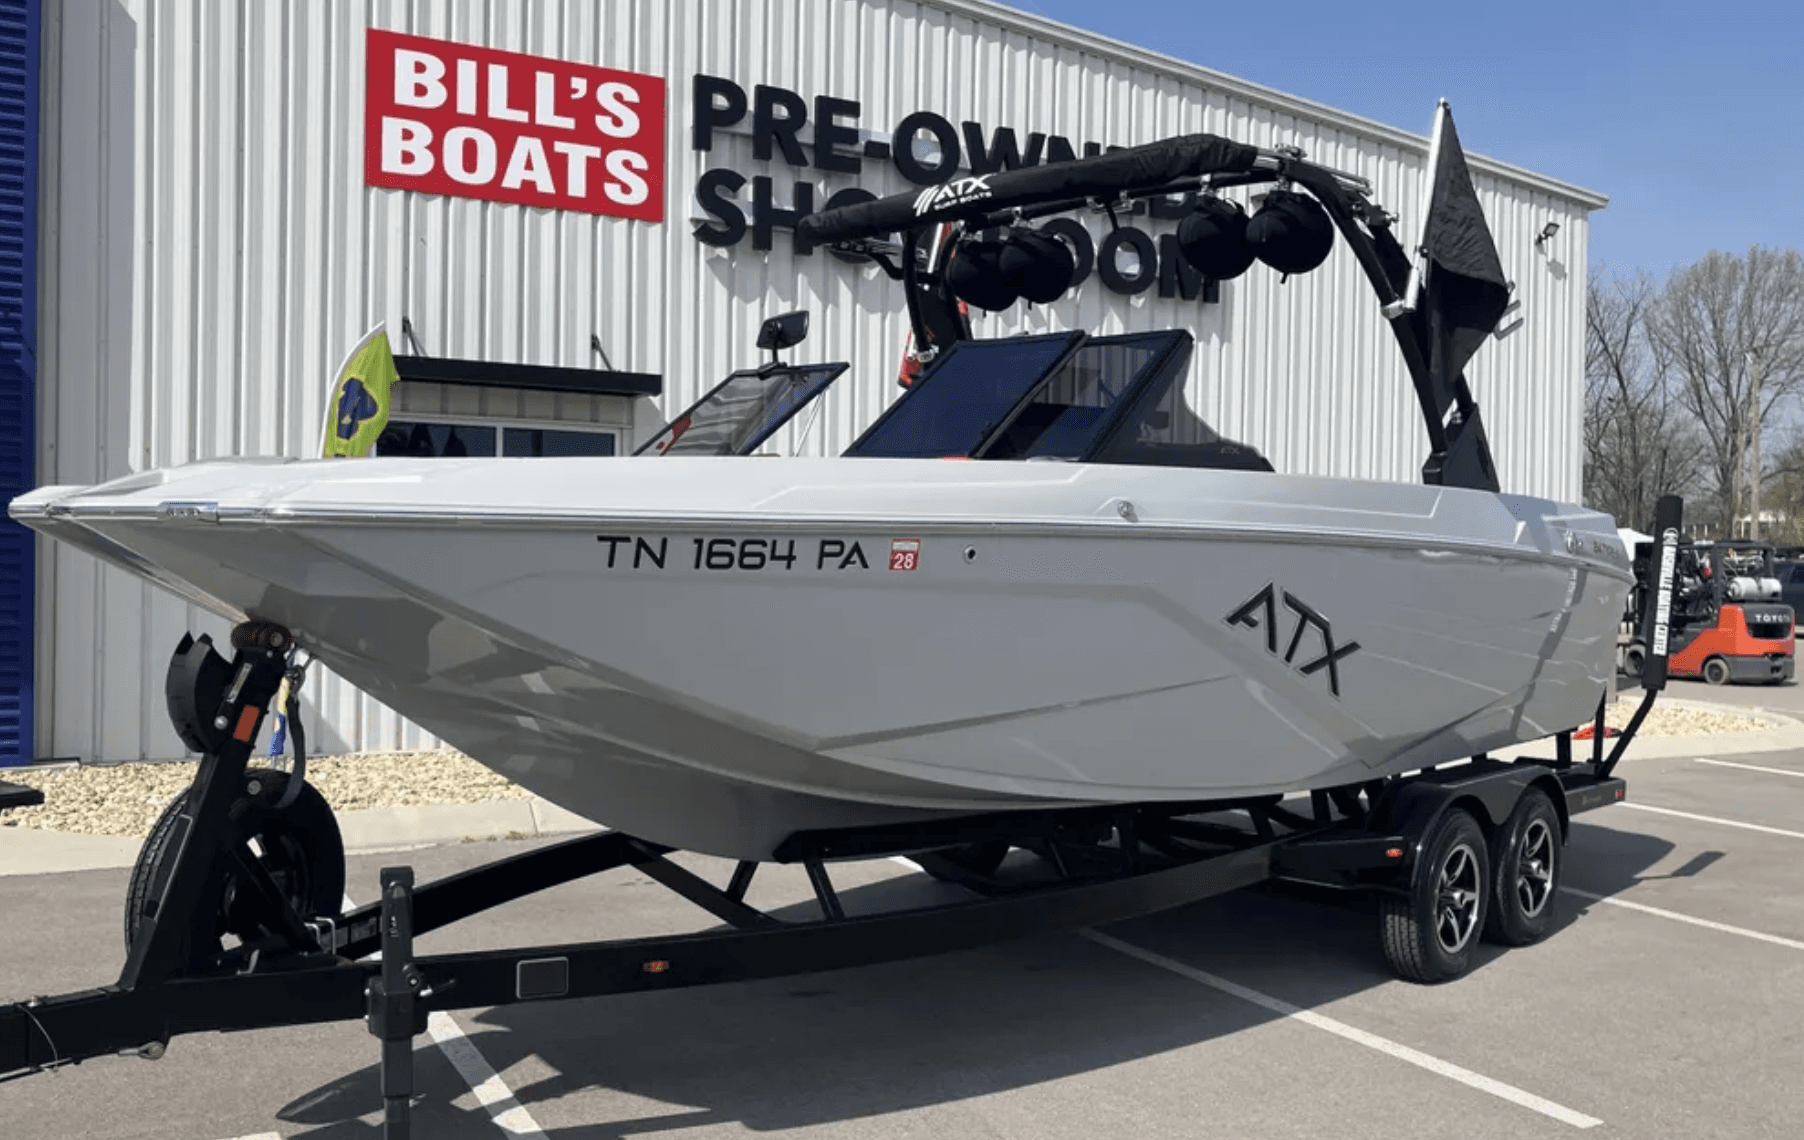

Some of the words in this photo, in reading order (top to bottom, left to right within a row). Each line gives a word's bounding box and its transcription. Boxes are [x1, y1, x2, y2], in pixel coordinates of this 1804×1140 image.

[393, 47, 641, 138] BILL'S
[380, 116, 650, 206] BOATS
[933, 173, 997, 203] ATX
[597, 535, 668, 569] TN
[693, 538, 797, 570] 1664
[817, 541, 870, 570] PA
[893, 552, 914, 569] 28
[1223, 580, 1362, 699] ATX
